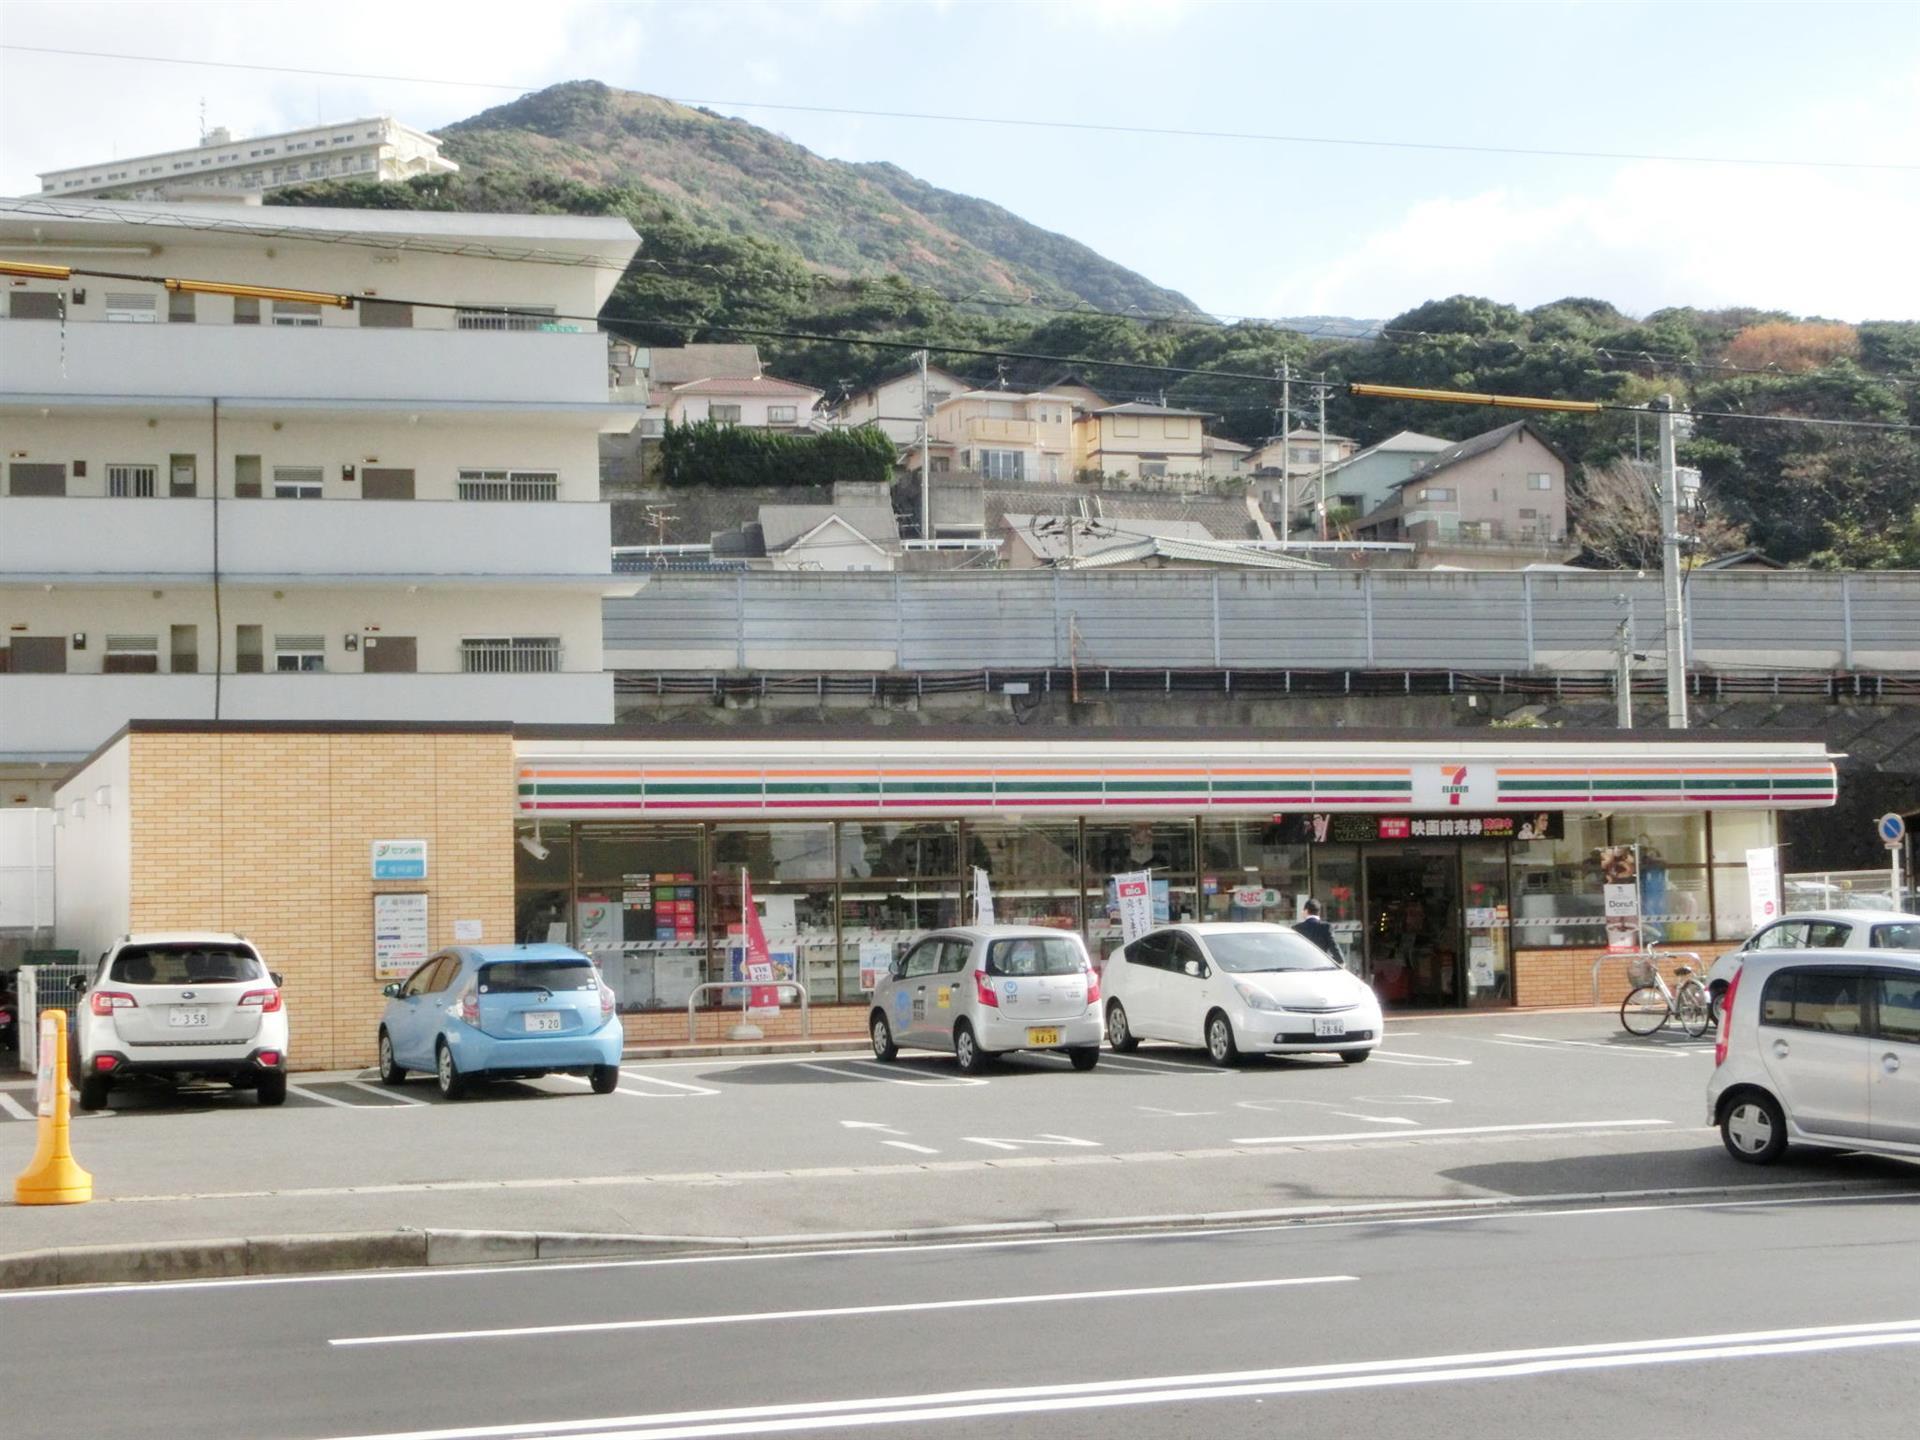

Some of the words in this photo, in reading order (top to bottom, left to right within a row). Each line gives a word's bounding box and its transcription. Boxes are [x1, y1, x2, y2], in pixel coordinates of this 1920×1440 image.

[1411, 819, 1482, 836] 映画前売券
[1239, 892, 1261, 903] たばこ
[1609, 900, 1634, 908] Donut
[878, 1133, 1104, 1154] IN
